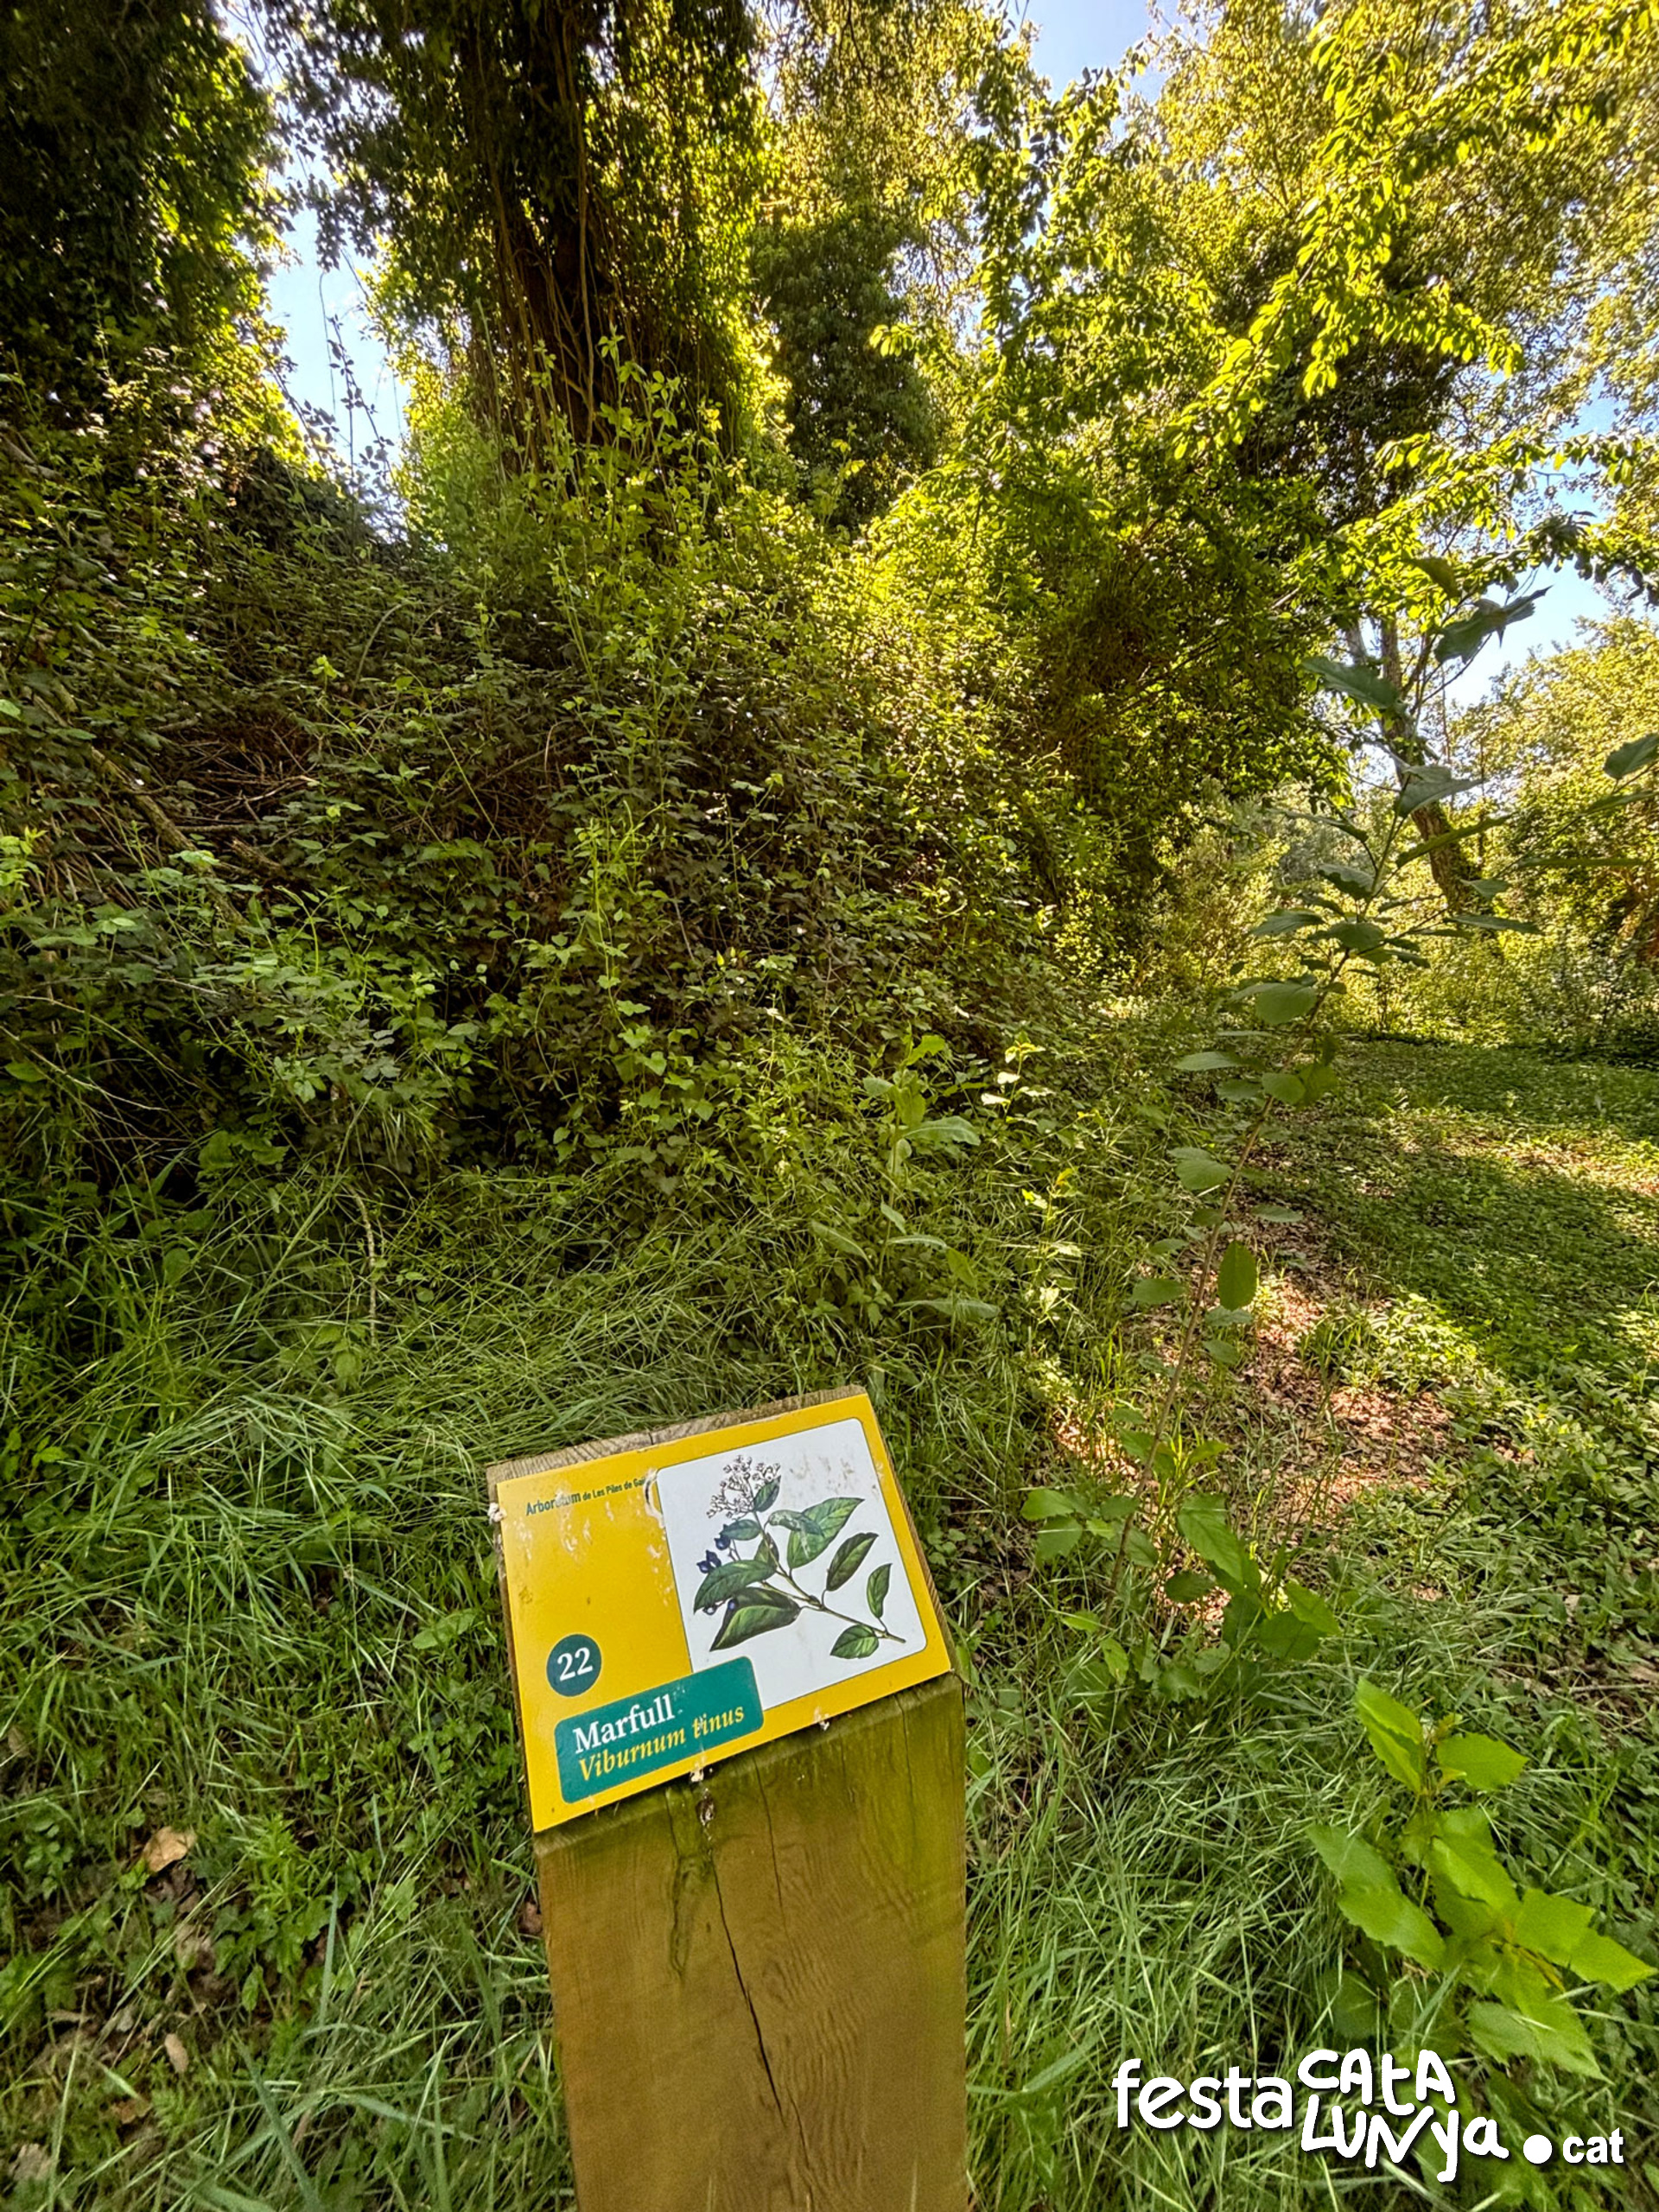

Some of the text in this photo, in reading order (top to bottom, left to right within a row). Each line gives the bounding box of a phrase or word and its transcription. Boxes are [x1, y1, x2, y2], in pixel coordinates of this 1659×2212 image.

[582, 1491, 592, 1501] de
[592, 1489, 605, 1498] Les
[606, 1484, 623, 1495] Piles
[624, 1480, 632, 1491] de
[556, 1646, 594, 1681] 22
[572, 1693, 676, 1754] Marfull
[578, 1706, 745, 1782] Viburnum tinus
